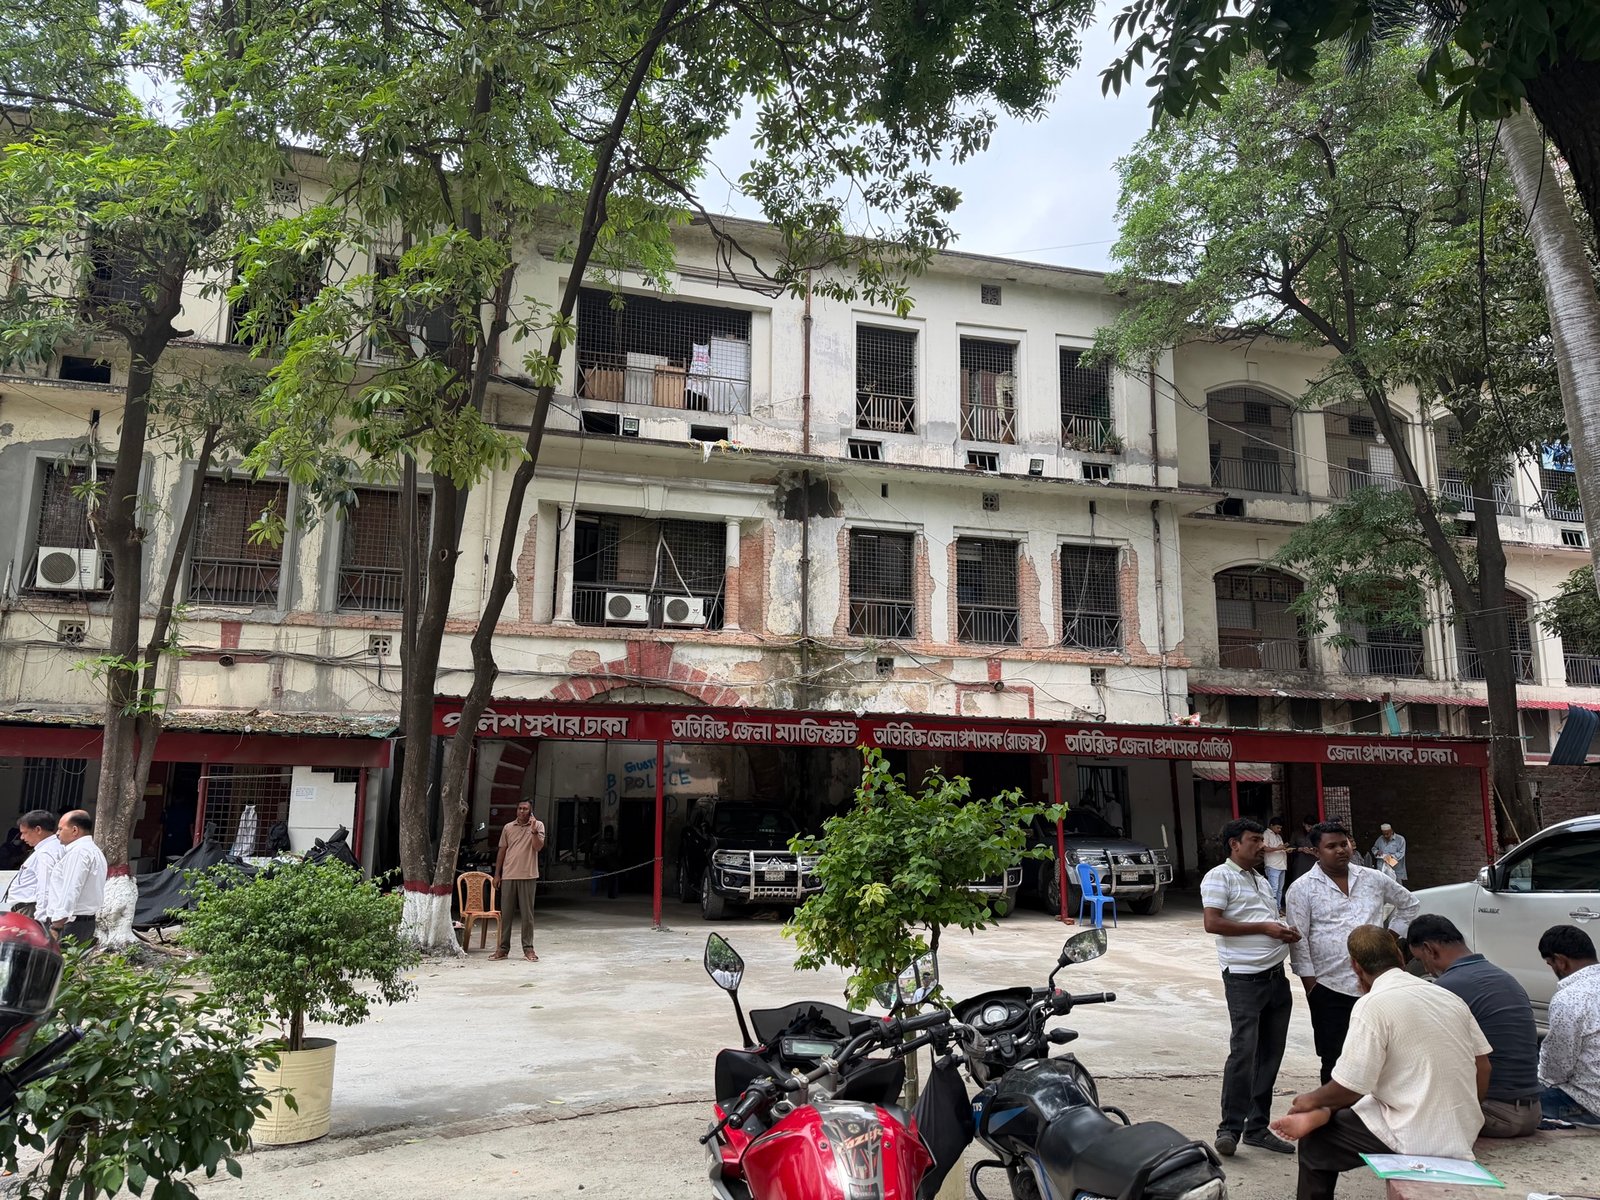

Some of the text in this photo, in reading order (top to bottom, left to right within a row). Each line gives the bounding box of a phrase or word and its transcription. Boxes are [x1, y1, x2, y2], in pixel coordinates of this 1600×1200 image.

[671, 714, 729, 740] অতিরিক্ত
[731, 721, 773, 742] জেলা
[873, 722, 928, 747] অতিরিক্ত
[927, 730, 959, 748] জেলা
[958, 728, 1004, 750] প্রশাসক
[1064, 730, 1118, 754] অতিরিক্ত
[1119, 737, 1154, 755] জেলা
[1153, 737, 1199, 757] প্রশাসক
[1327, 744, 1363, 762] জেলা
